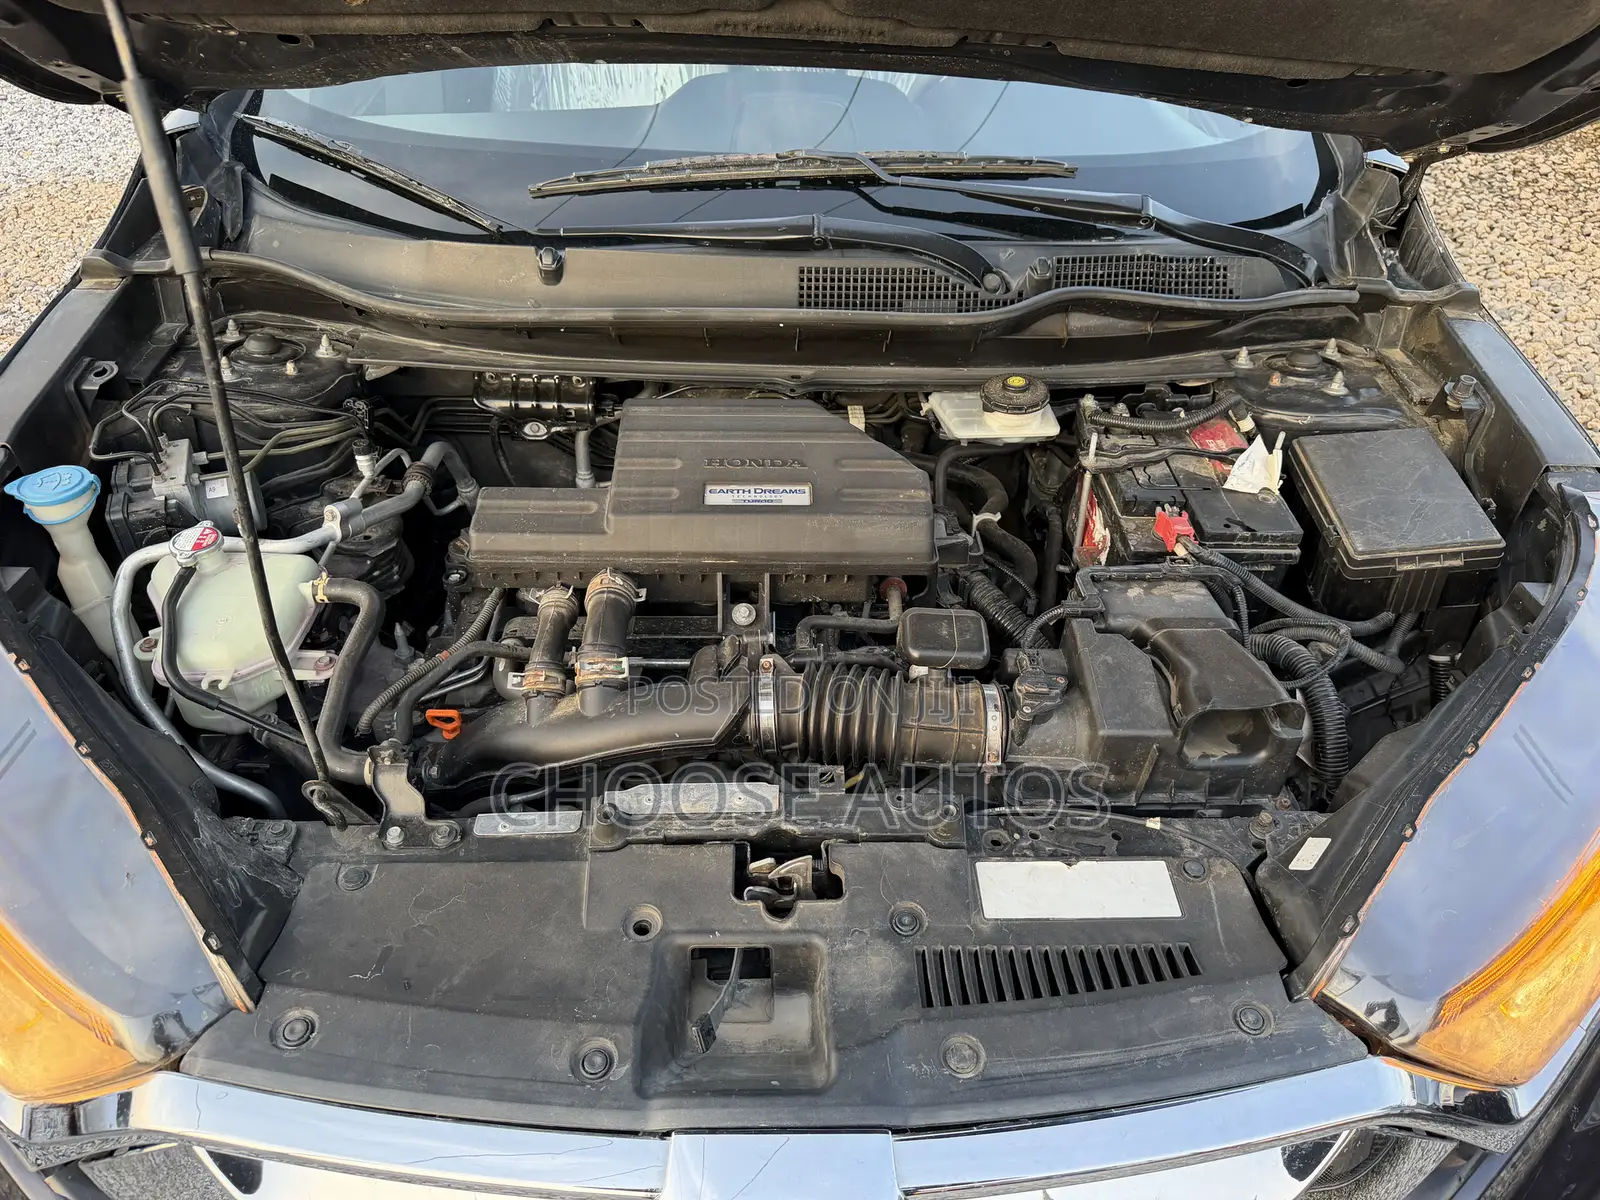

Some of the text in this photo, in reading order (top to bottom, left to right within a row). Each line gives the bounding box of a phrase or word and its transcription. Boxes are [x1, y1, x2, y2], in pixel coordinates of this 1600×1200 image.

[703, 458, 809, 470] HONDA
[708, 487, 806, 495] EARTH DREAMS
